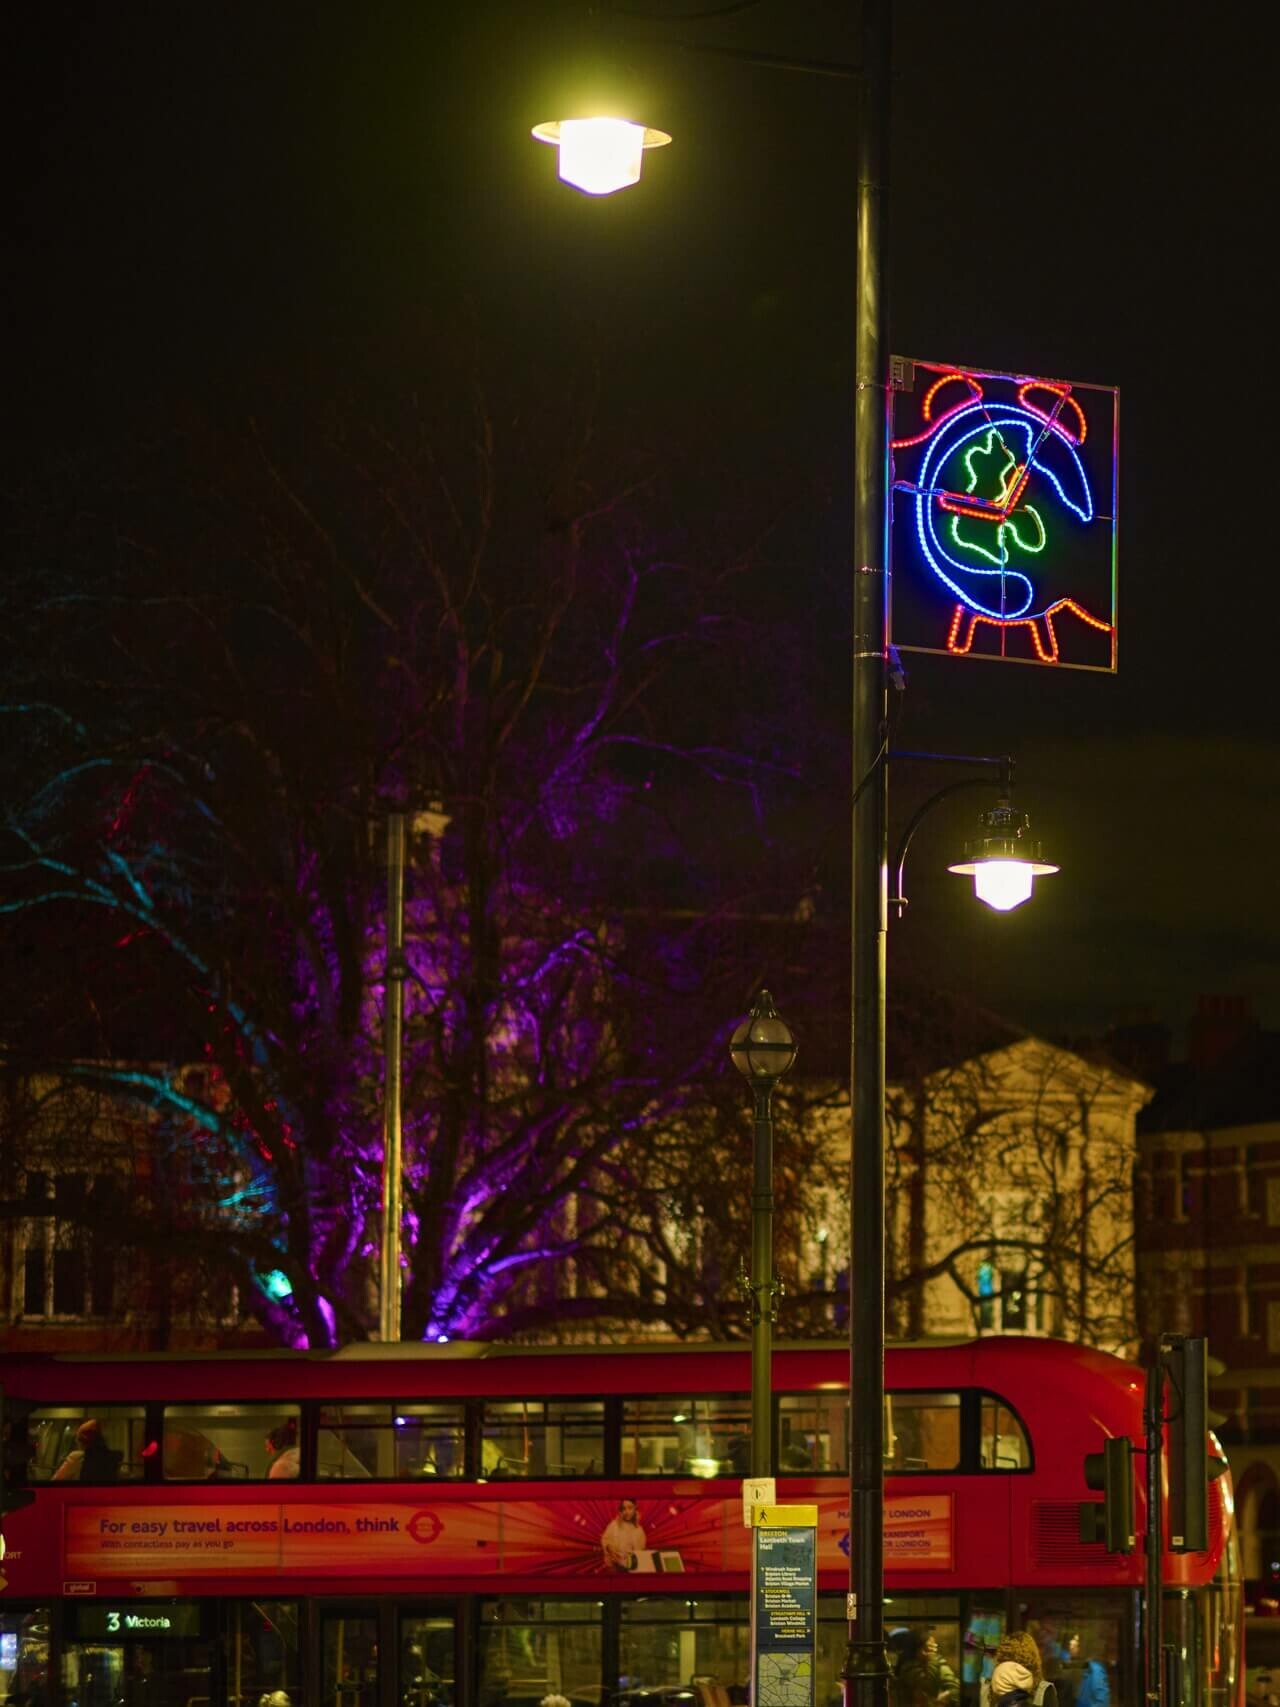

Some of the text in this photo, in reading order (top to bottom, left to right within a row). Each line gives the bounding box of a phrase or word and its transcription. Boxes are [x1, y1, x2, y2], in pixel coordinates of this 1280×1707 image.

[889, 1510, 931, 1519] LONDON
[100, 1519, 126, 1534] For
[131, 1521, 168, 1537] easy
[173, 1518, 221, 1533] travel
[226, 1520, 278, 1533] across
[284, 1517, 350, 1534] London,
[355, 1517, 399, 1532] think
[884, 1530, 925, 1538] RANSPORT
[124, 1540, 173, 1549] contactless
[175, 1541, 191, 1550] pay
[205, 1541, 221, 1549] you
[223, 1541, 234, 1549] go
[106, 1612, 171, 1632] 3 Victoria
